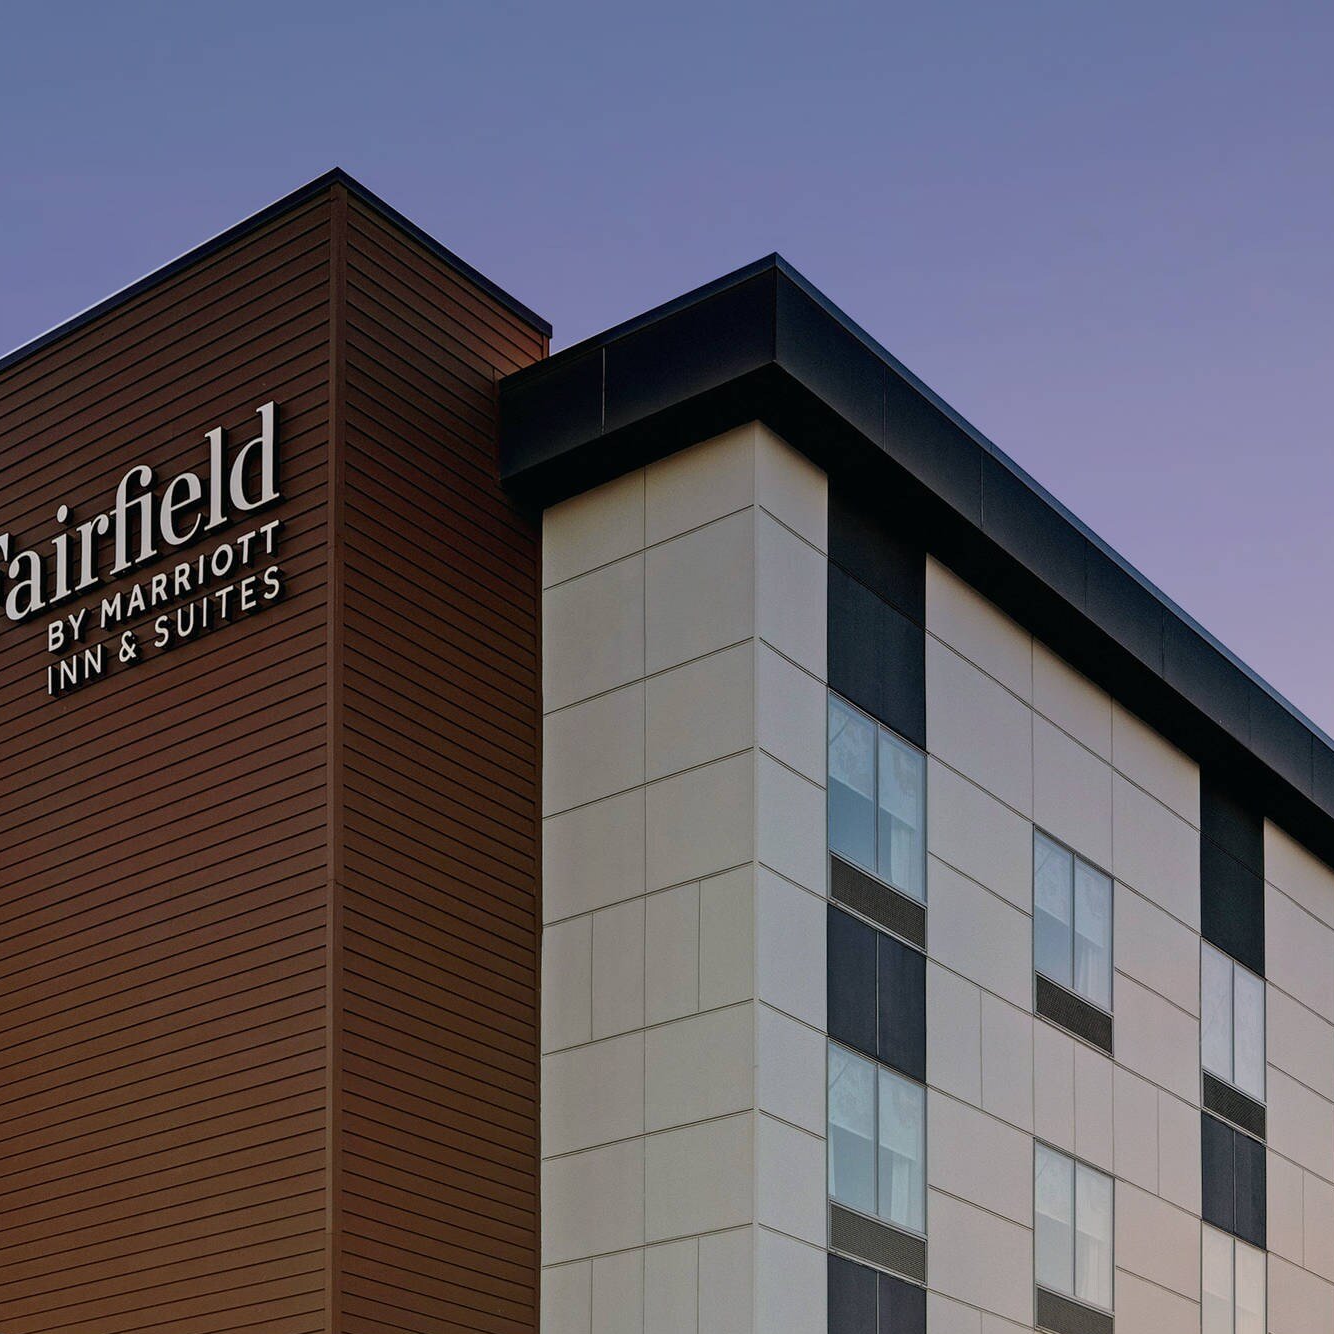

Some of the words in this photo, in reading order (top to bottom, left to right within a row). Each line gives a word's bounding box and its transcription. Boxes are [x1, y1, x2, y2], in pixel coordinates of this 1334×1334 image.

[47, 643, 103, 695] INN
[119, 630, 138, 663] &
[154, 565, 280, 648] SUITES
[48, 608, 87, 652] BY
[100, 519, 280, 629] MARRIOTT
